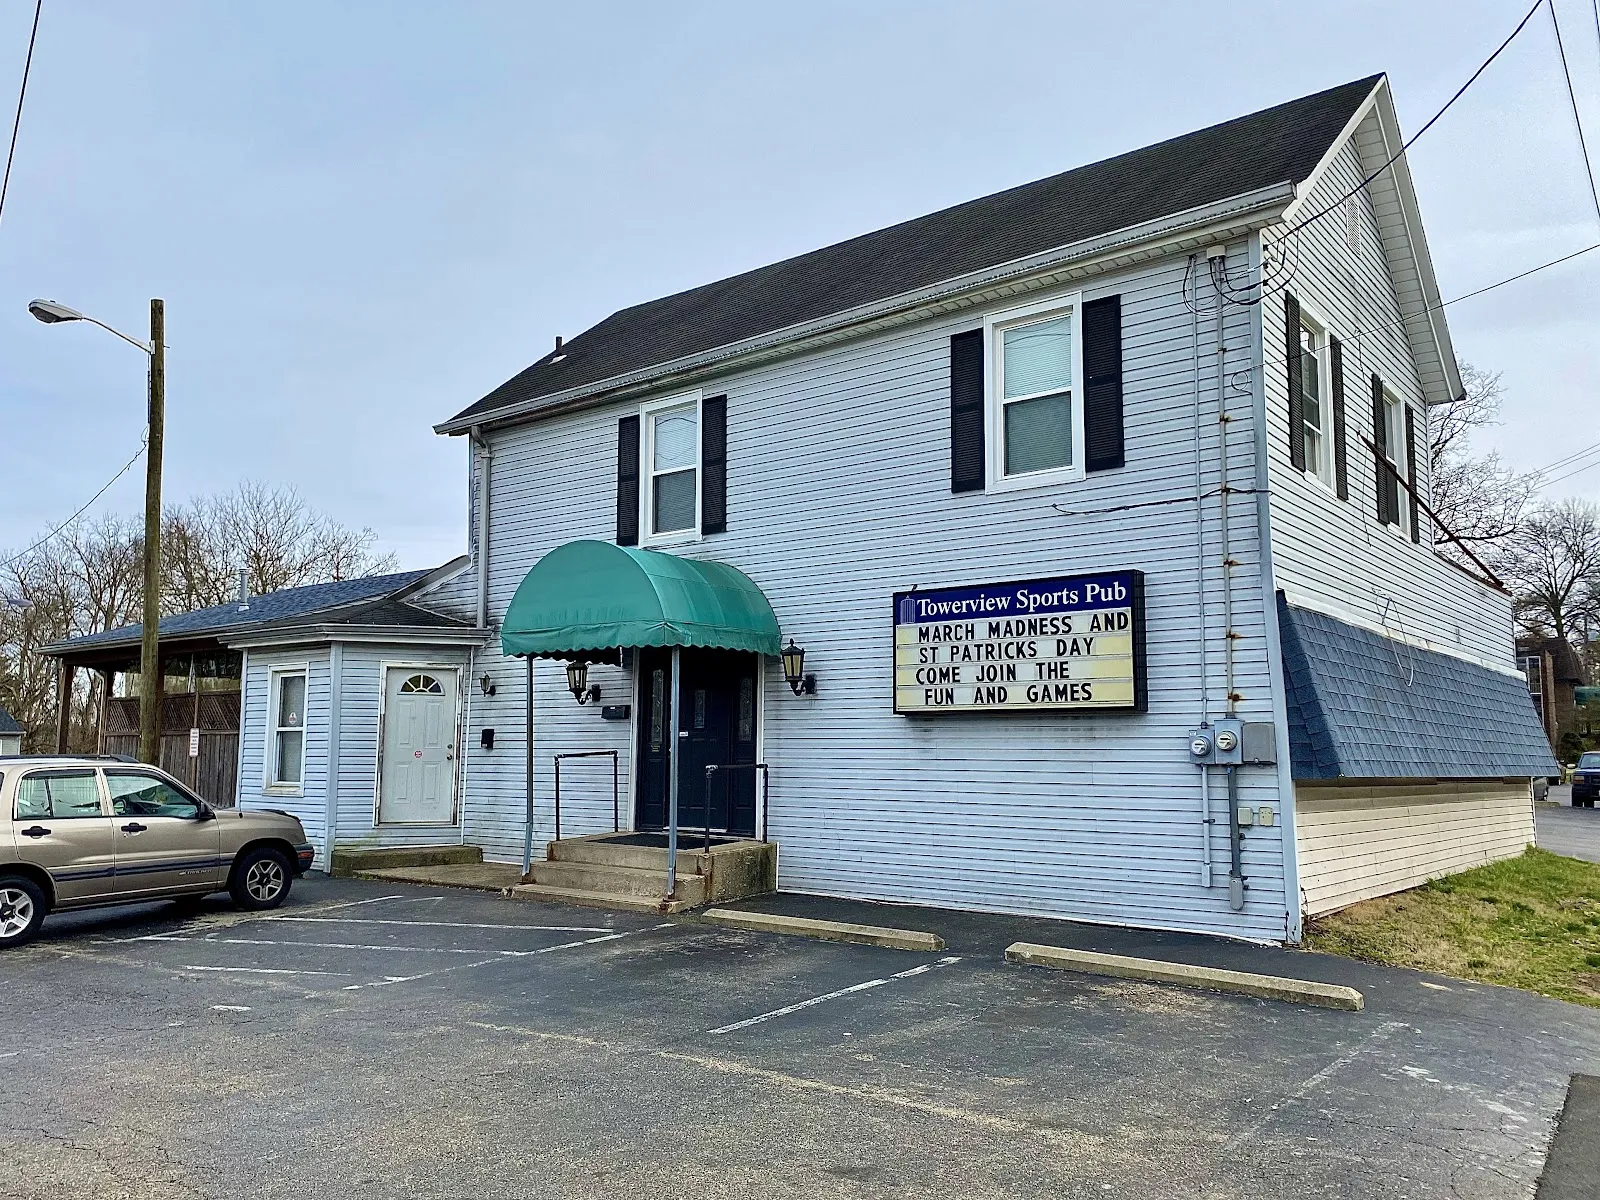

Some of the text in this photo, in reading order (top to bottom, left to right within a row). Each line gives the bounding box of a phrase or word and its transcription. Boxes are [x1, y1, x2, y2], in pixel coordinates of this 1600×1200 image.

[916, 581, 1127, 616] Towerview Sports Pub
[918, 611, 1129, 643] MARCH MADNESS AND
[919, 636, 1095, 664] ST PATRICKS DAY
[915, 660, 1070, 686] COME JOIN THE
[924, 682, 1092, 706] FUN AND GAMES
